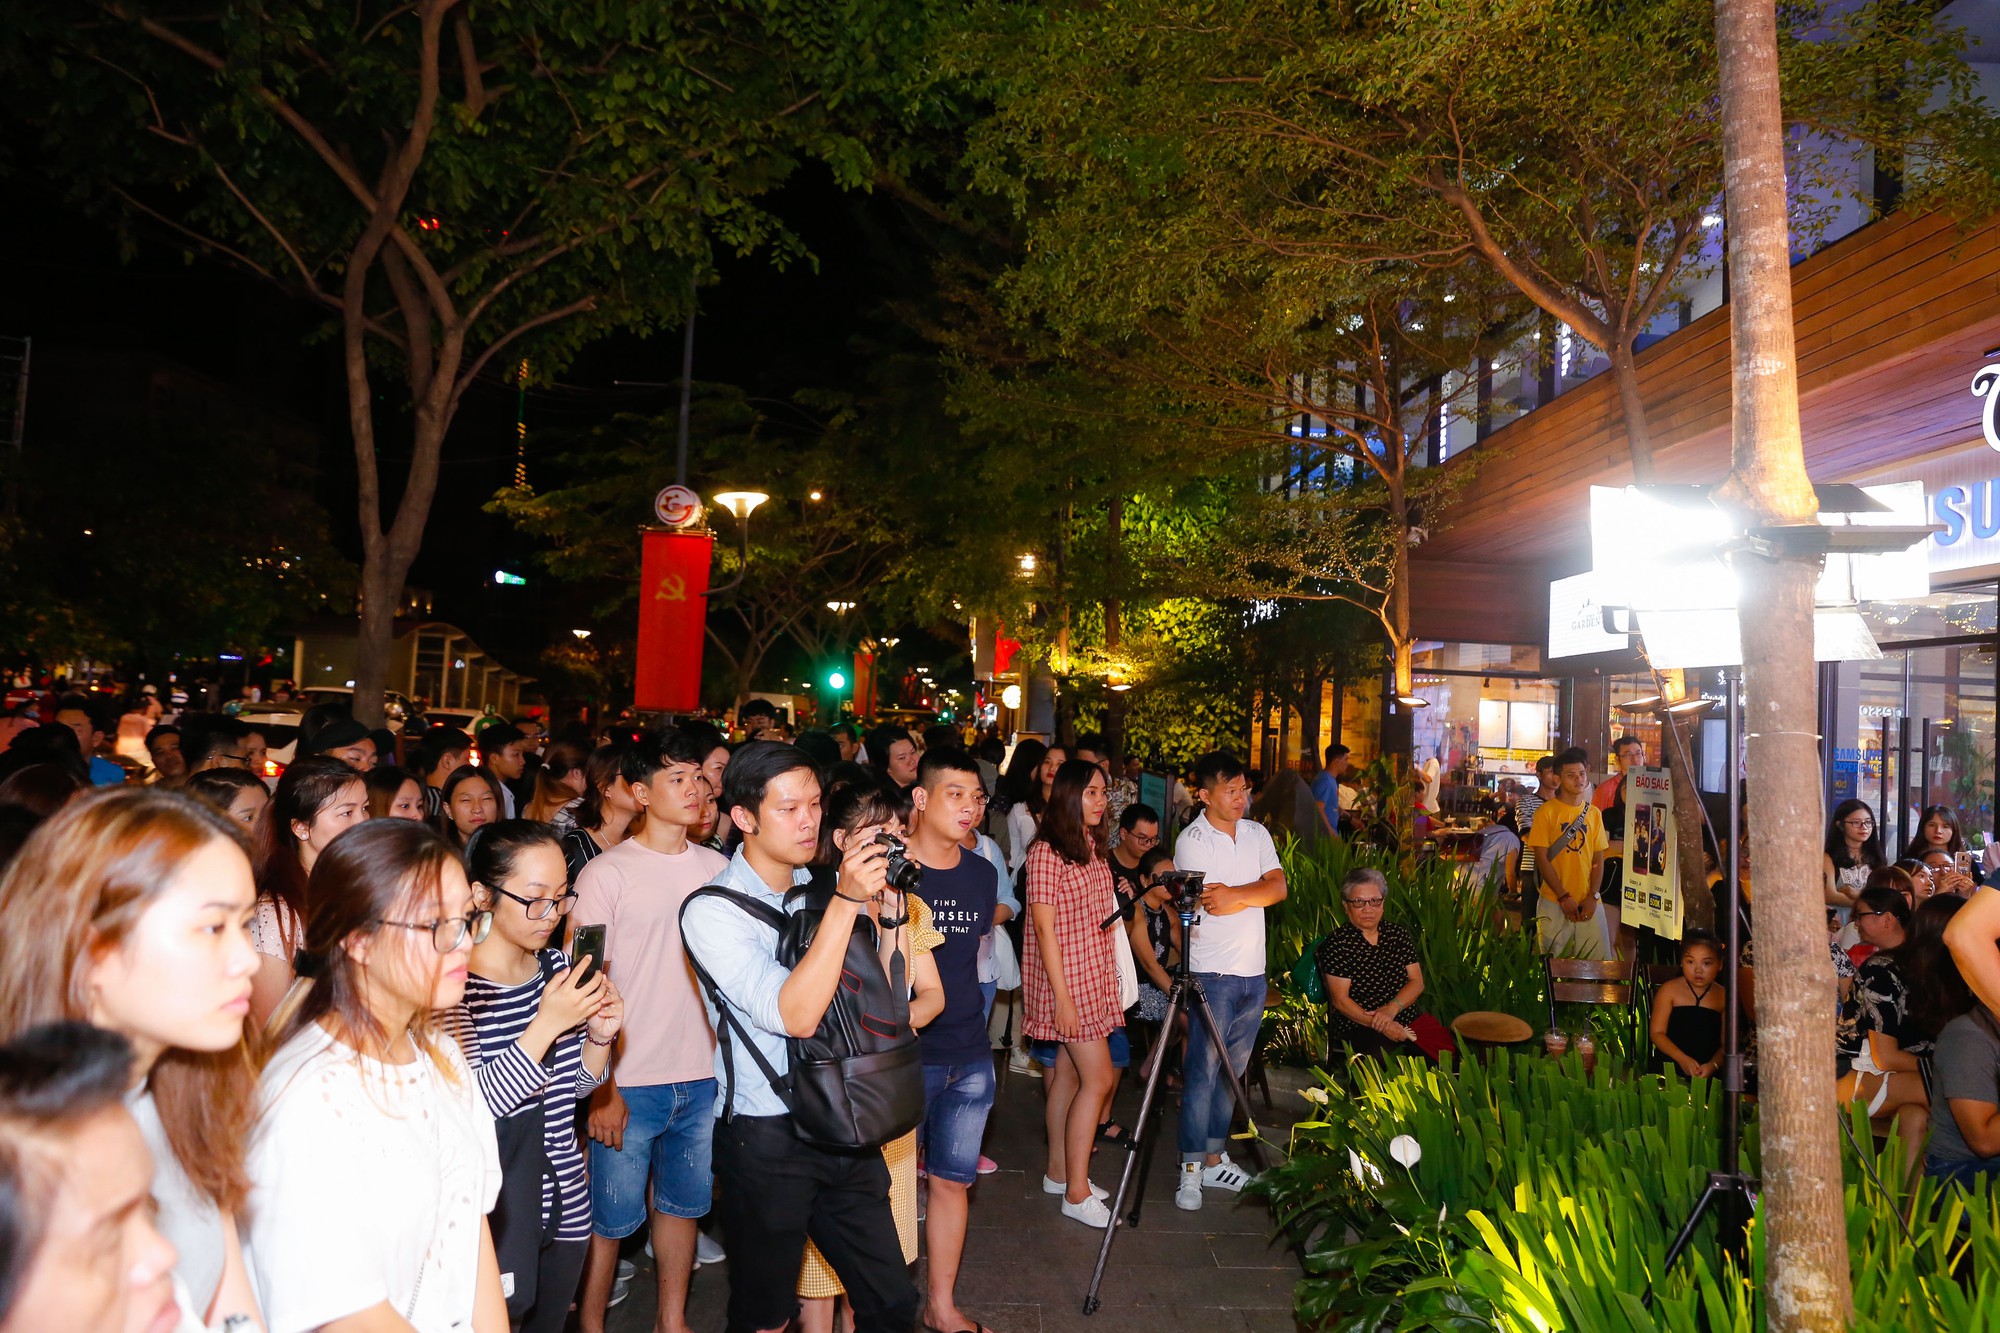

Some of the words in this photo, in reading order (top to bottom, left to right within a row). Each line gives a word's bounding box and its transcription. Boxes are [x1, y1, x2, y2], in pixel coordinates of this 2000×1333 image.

[1571, 617, 1600, 630] GARDEN
[1651, 777, 1669, 790] SALE
[933, 899, 957, 907] FIND
[951, 926, 970, 934] THAT
